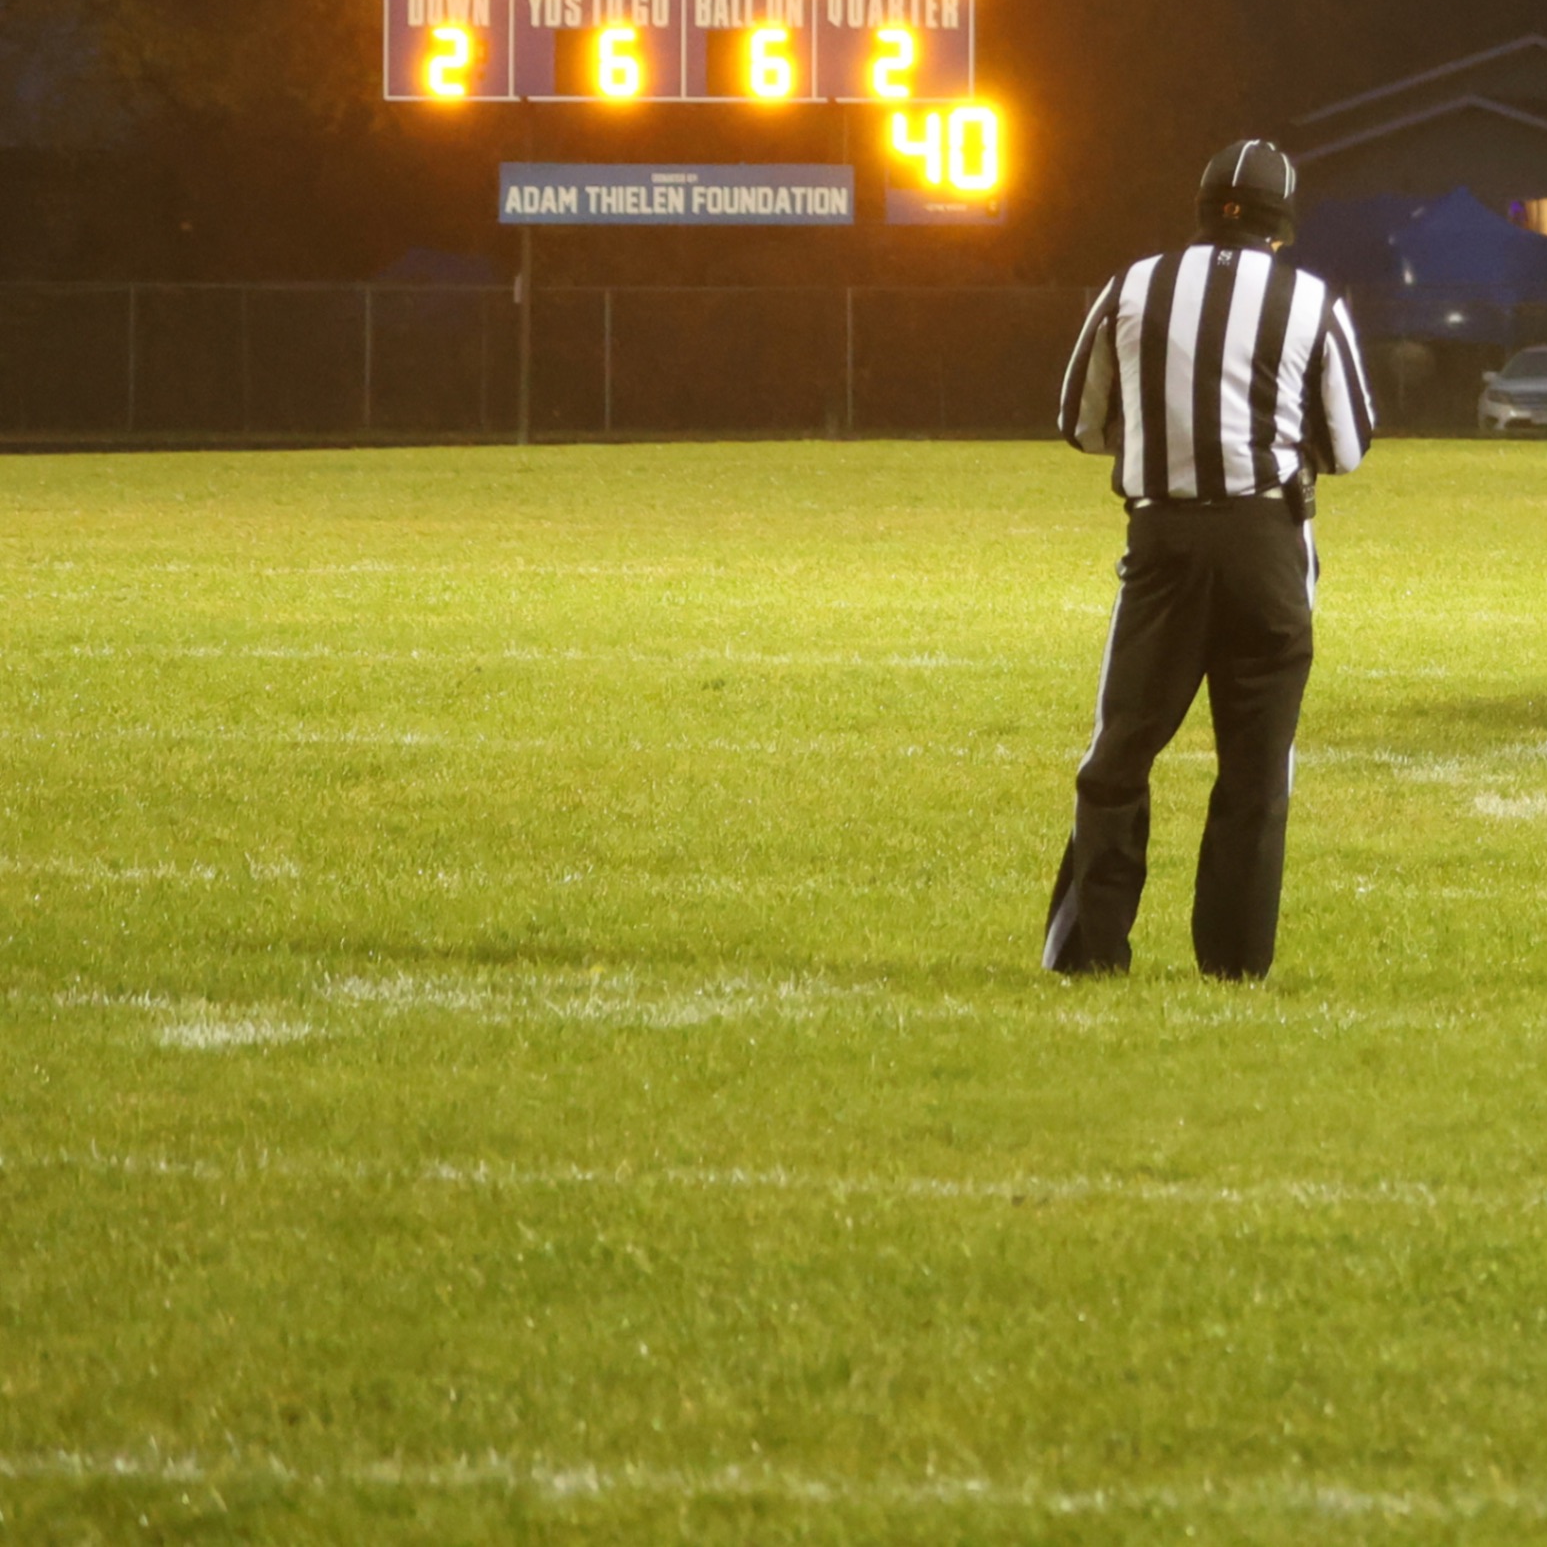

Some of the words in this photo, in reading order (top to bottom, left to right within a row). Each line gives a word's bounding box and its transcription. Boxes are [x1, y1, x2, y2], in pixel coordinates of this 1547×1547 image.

[427, 26, 470, 98] 2
[598, 27, 640, 98] 6
[749, 27, 792, 98] 6
[872, 28, 914, 99] 2
[891, 105, 998, 191] 40
[504, 185, 578, 214] ADAM
[584, 185, 684, 215] THIELEN
[691, 186, 849, 216] FOUNDATION
